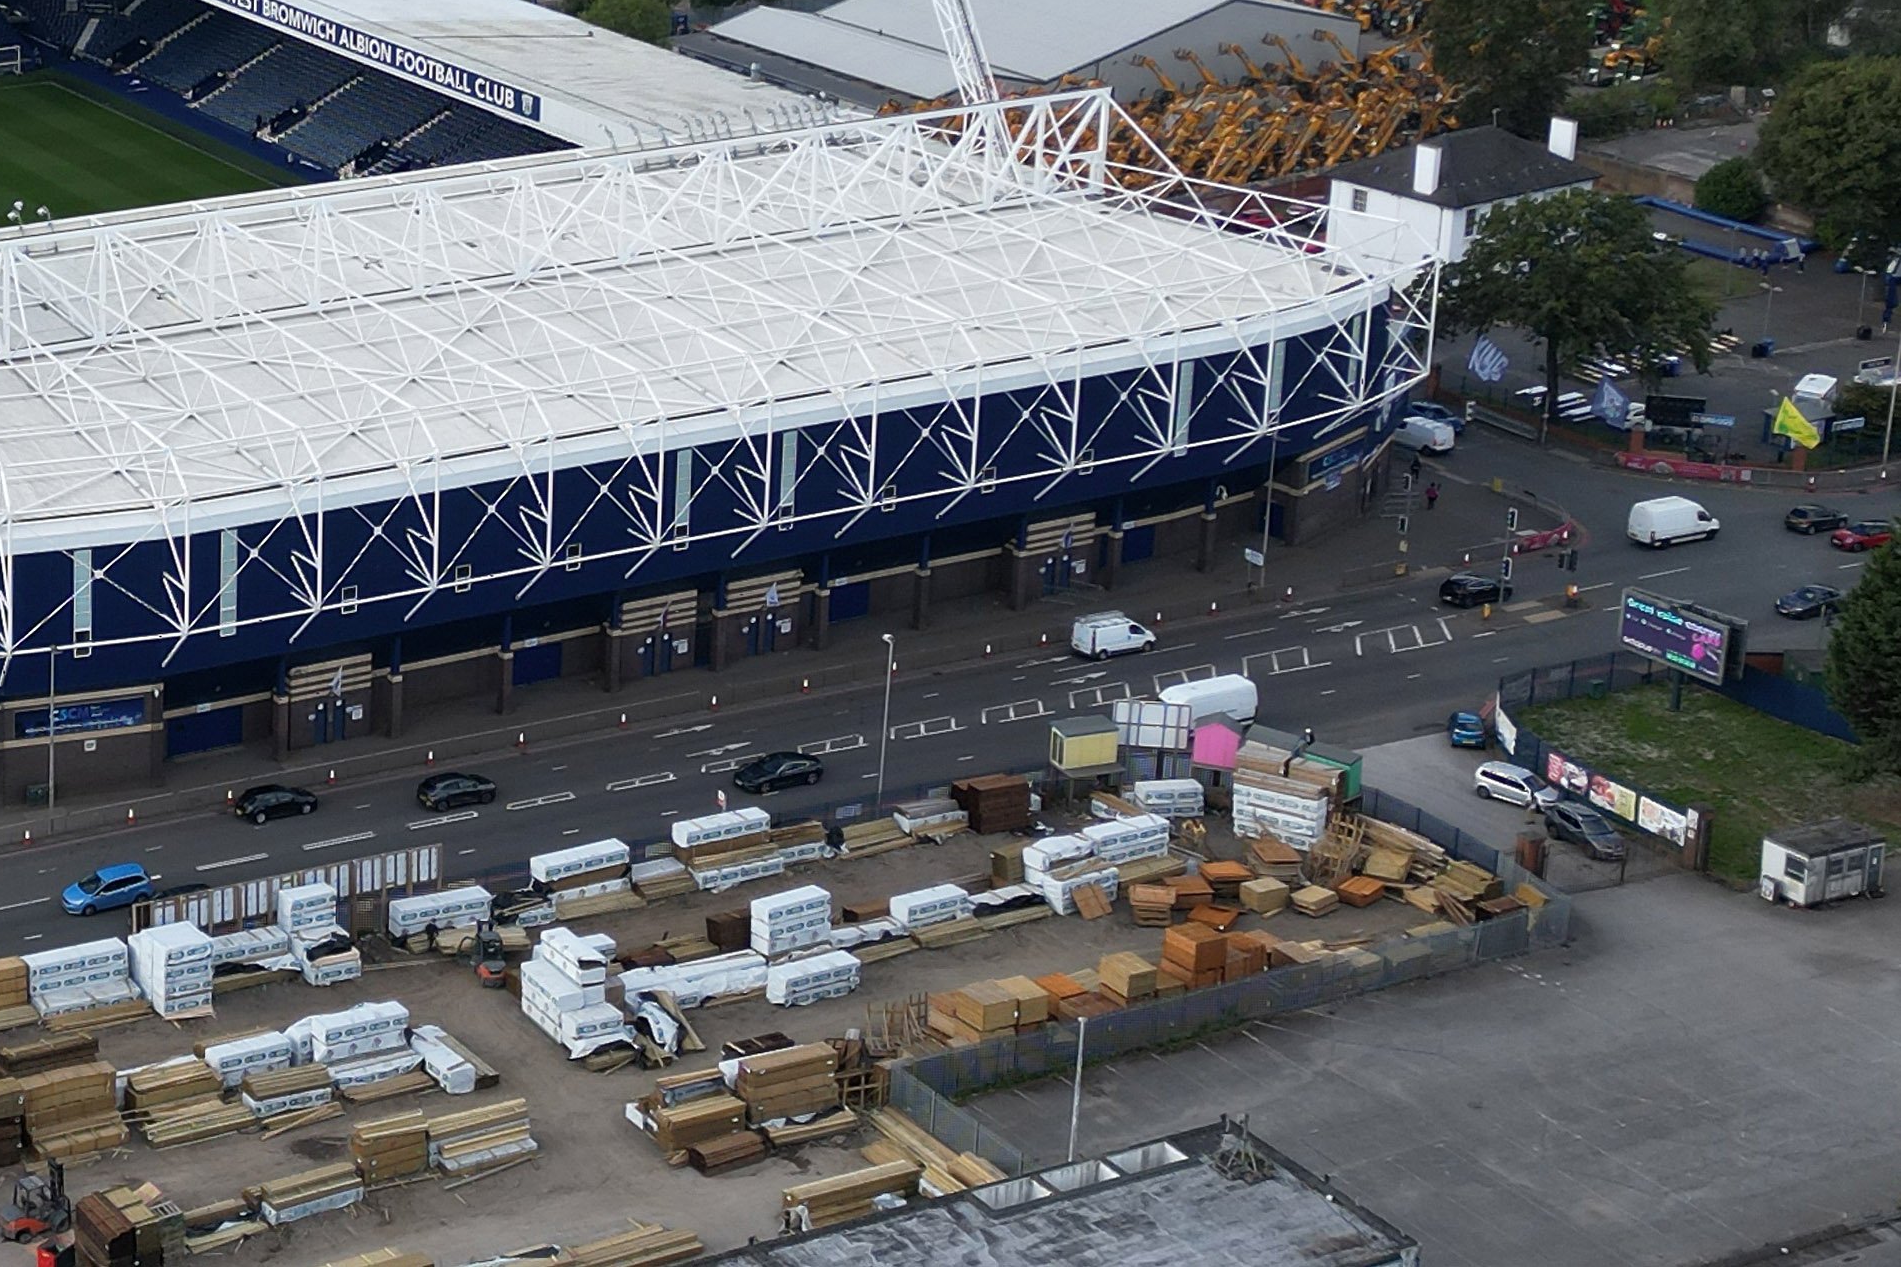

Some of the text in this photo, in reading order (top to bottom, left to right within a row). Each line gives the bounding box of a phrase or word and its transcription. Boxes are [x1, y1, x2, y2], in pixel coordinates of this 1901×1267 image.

[339, 27, 393, 65] ALBION
[395, 48, 472, 93] FOOTBALL
[474, 78, 516, 110] CLUB
